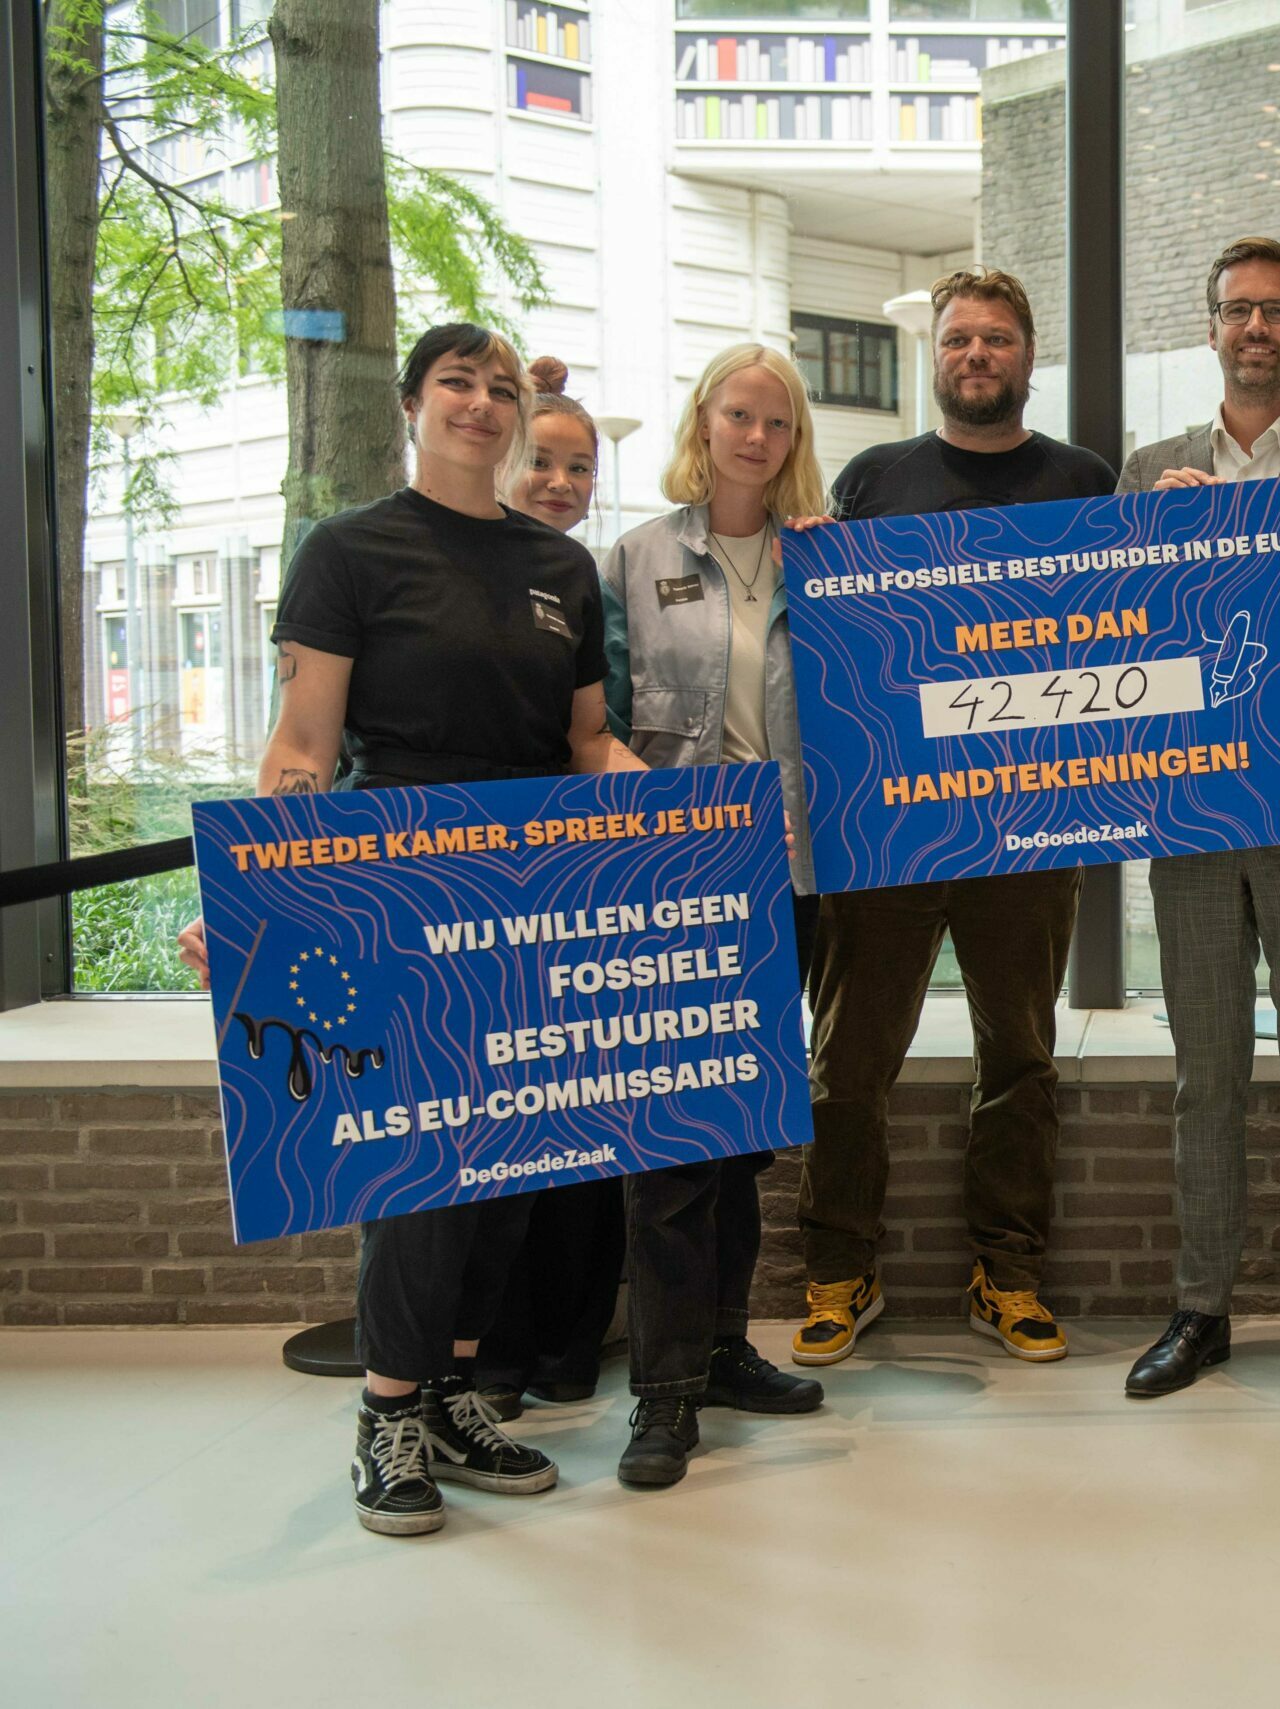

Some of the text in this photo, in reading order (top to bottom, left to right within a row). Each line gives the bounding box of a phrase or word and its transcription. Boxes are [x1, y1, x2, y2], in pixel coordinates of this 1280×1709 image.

[804, 573, 875, 598] GEEN
[879, 561, 1003, 592] FOSSIELE
[1007, 543, 1180, 579] BESTUURDER
[1183, 539, 1212, 561] IN
[1216, 535, 1251, 558] DE
[956, 607, 1148, 653] MEER DAN
[883, 742, 1249, 805] HANDTEKENINGEN!
[230, 804, 752, 870] TWEEDE KAMER, SPREEK JE UIT!
[1005, 820, 1149, 851] DeGoedeZaak
[423, 892, 749, 954] WIJ WILLEN GEEN
[549, 944, 742, 998] FOSSIELE
[485, 998, 760, 1066] BESTUURDER
[332, 1053, 759, 1146] ALS EU-COMMISSARIS
[459, 1143, 617, 1187] DeGoedeZaak
